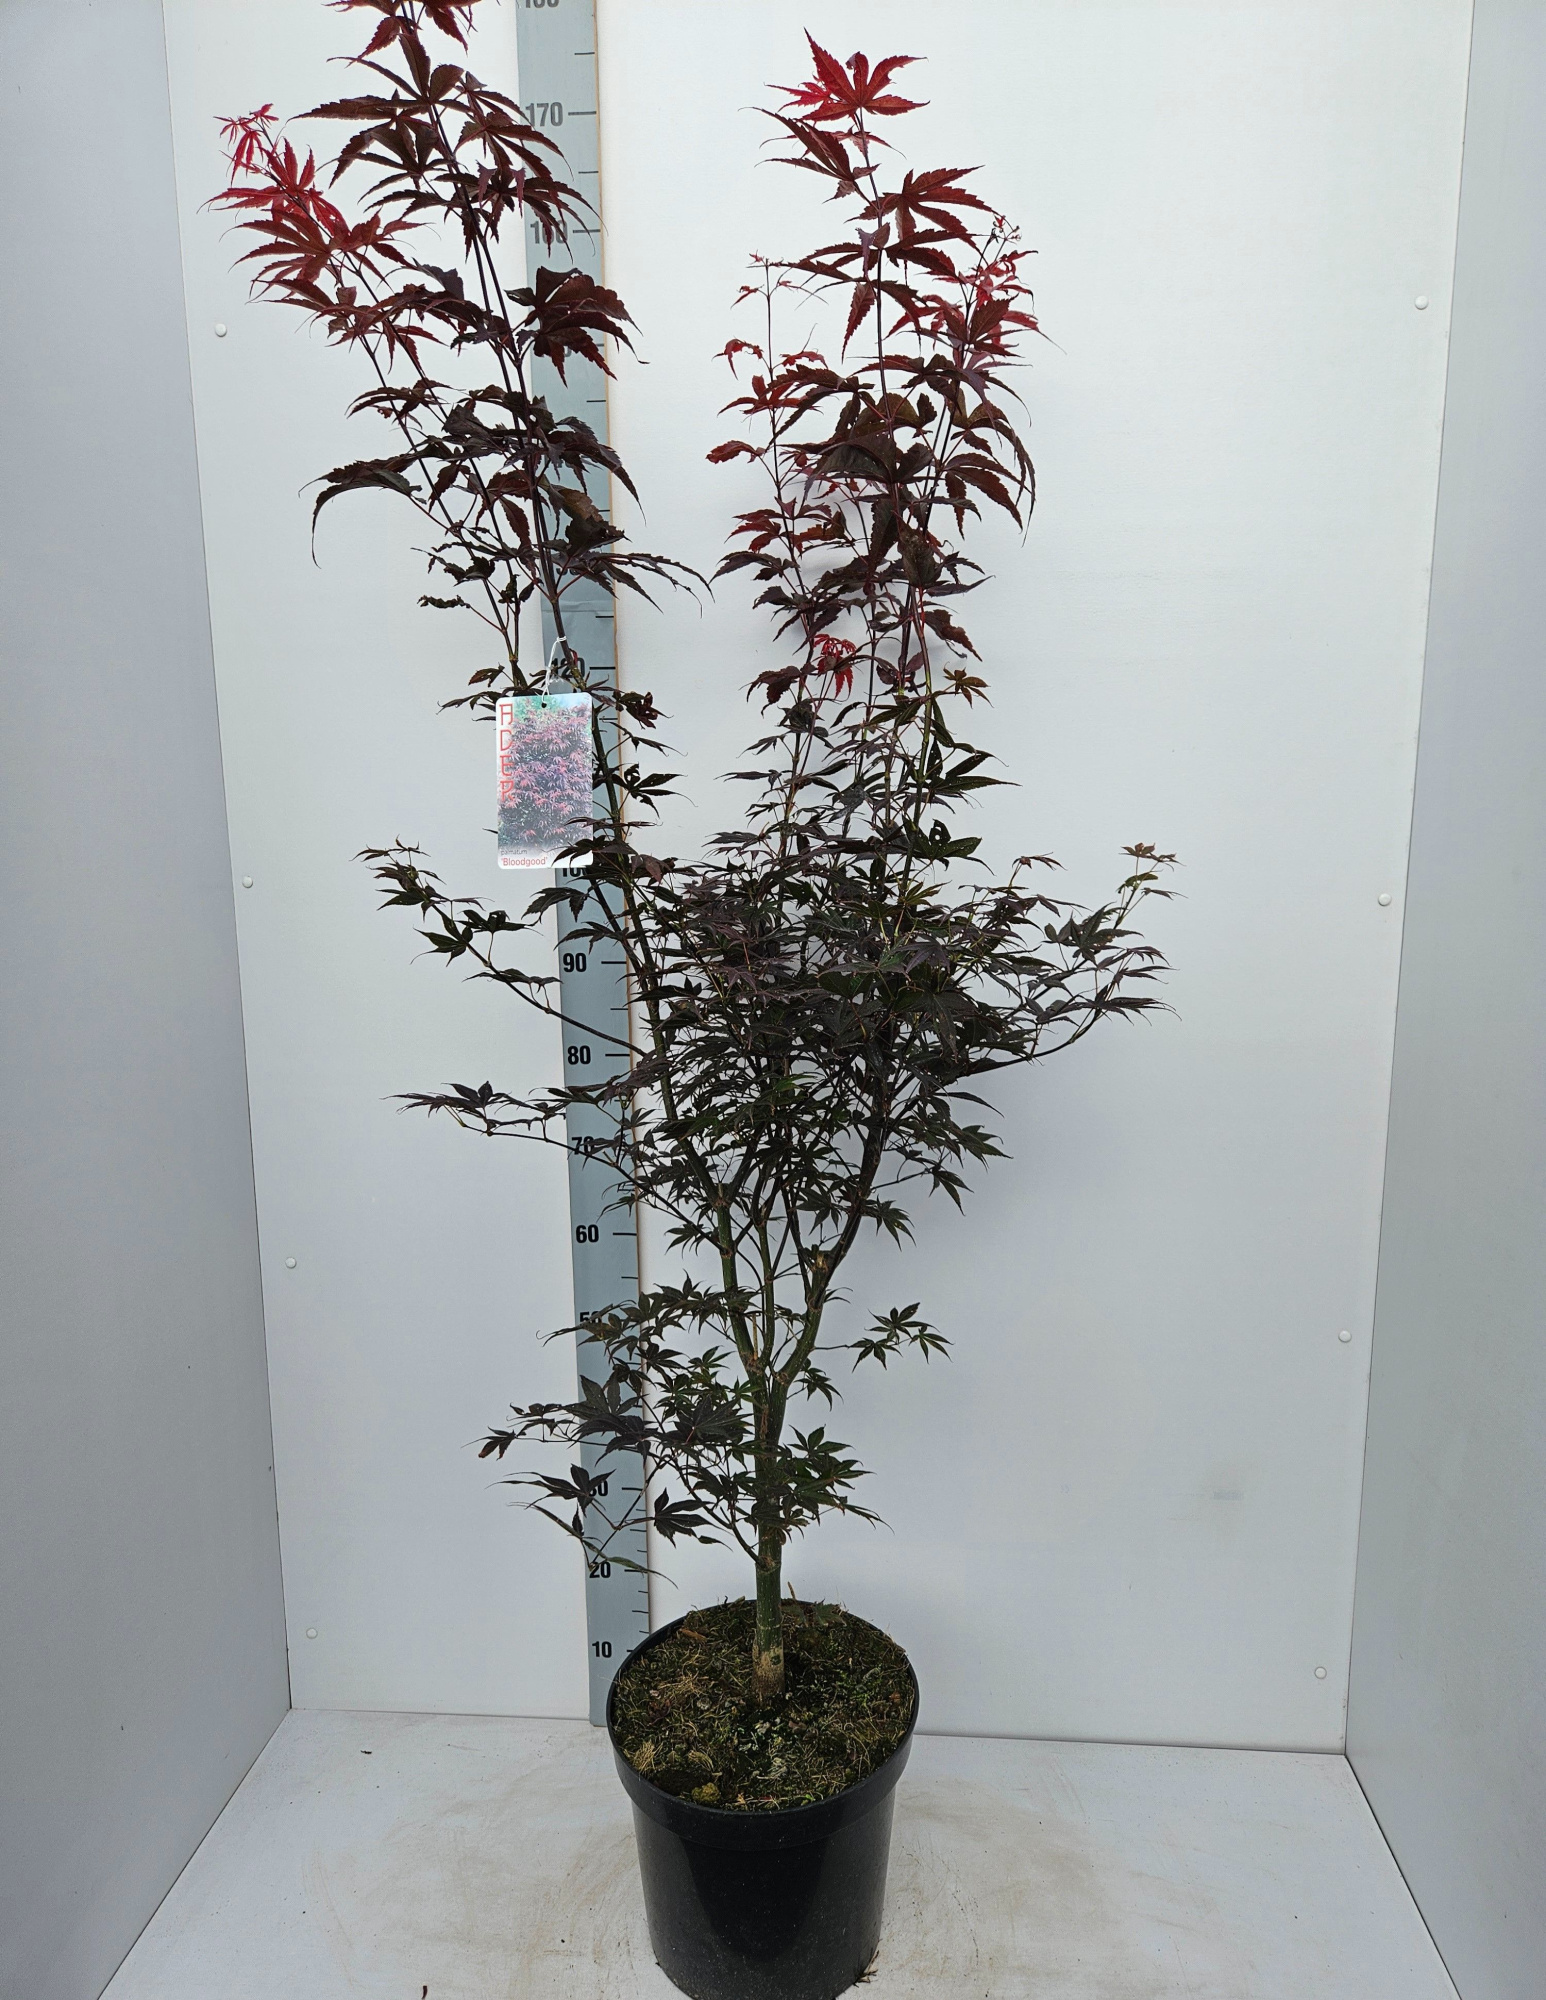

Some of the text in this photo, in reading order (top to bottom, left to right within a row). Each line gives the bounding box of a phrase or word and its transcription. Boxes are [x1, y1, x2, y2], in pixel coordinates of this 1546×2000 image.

[525, 102, 564, 126] 170
[501, 857, 548, 867] 'Bloodgood'
[563, 952, 587, 973] 90
[567, 1045, 592, 1065] 80
[576, 1224, 600, 1244] 60
[589, 1561, 611, 1578] 20
[592, 1641, 612, 1658] 10
